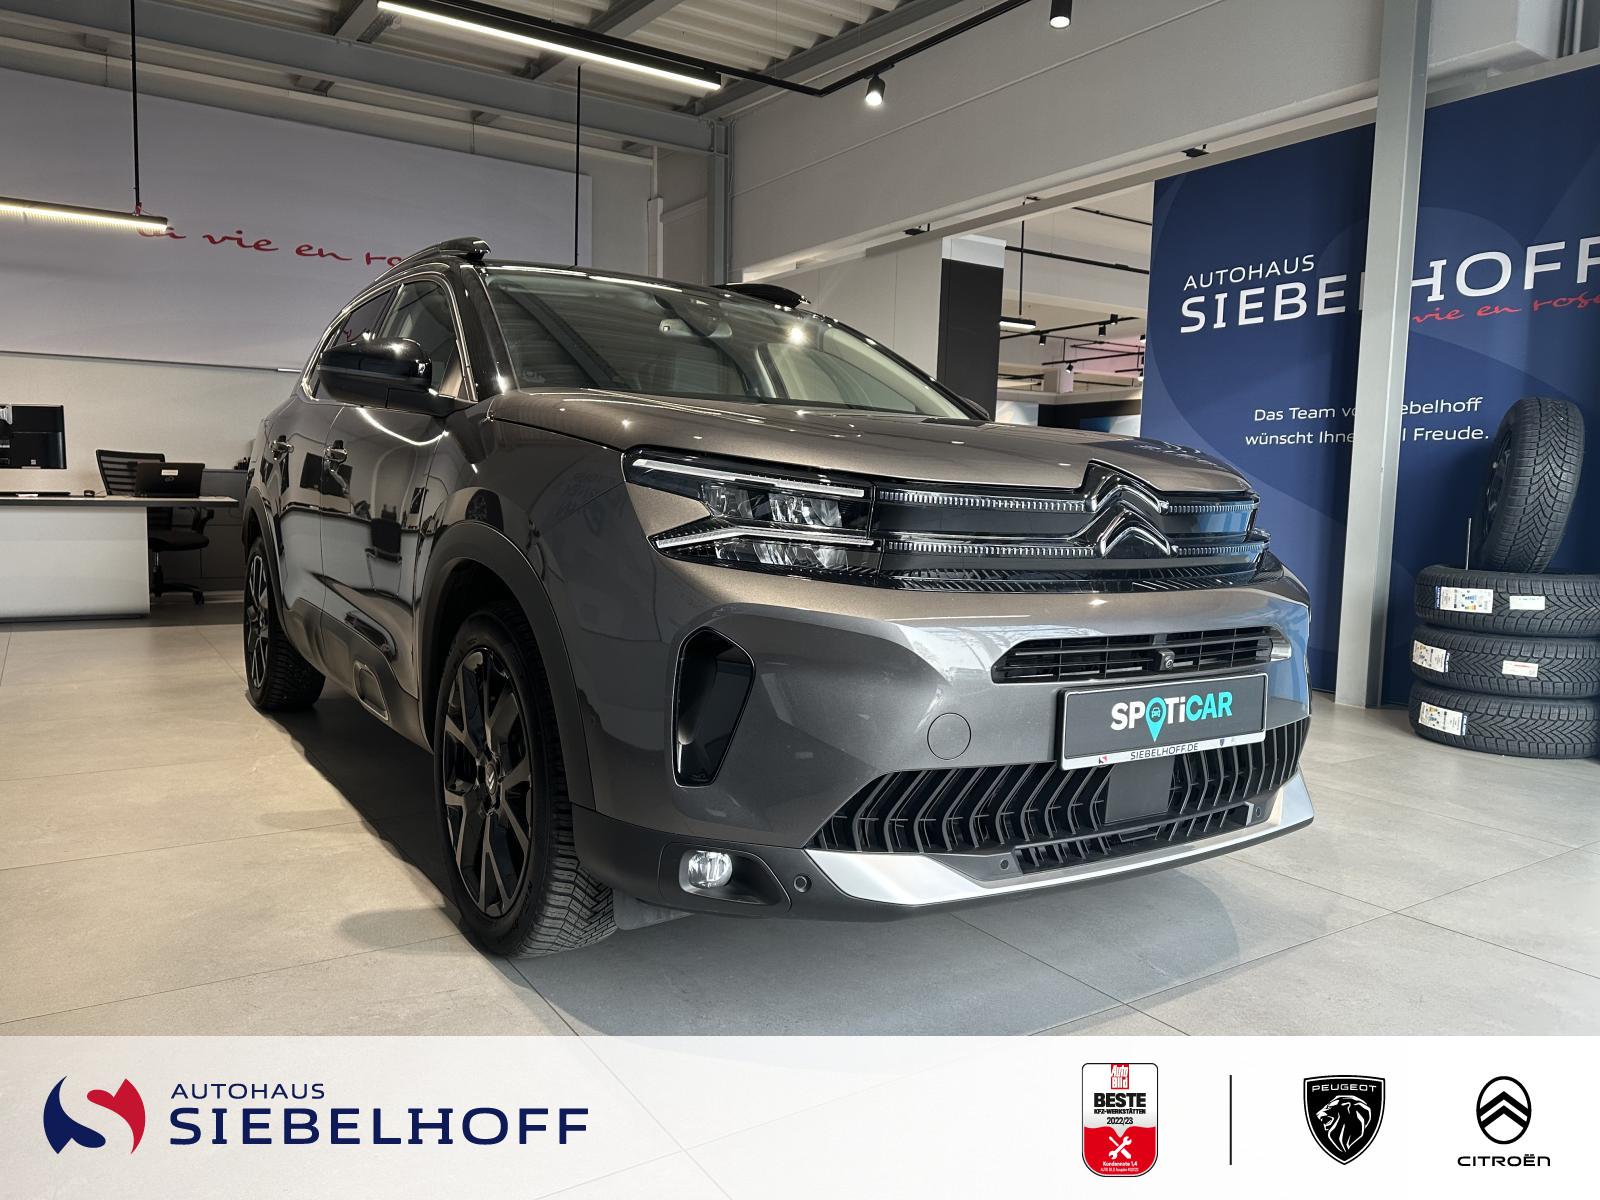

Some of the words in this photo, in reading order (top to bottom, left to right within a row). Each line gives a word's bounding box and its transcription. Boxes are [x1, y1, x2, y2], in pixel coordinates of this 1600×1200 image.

[202, 230, 279, 251] vie
[295, 244, 353, 261] en
[365, 252, 402, 268] ro
[1183, 254, 1315, 291] AUTOHAUS
[1411, 307, 1465, 324] vie
[1475, 304, 1522, 317] en
[1254, 409, 1284, 421] Das
[1288, 407, 1336, 419] Team
[1245, 432, 1314, 445] wünscht
[1319, 430, 1355, 443] Ihne
[1413, 425, 1489, 441] Freude.
[1130, 742, 1199, 760] SIEBELHOFF.DE
